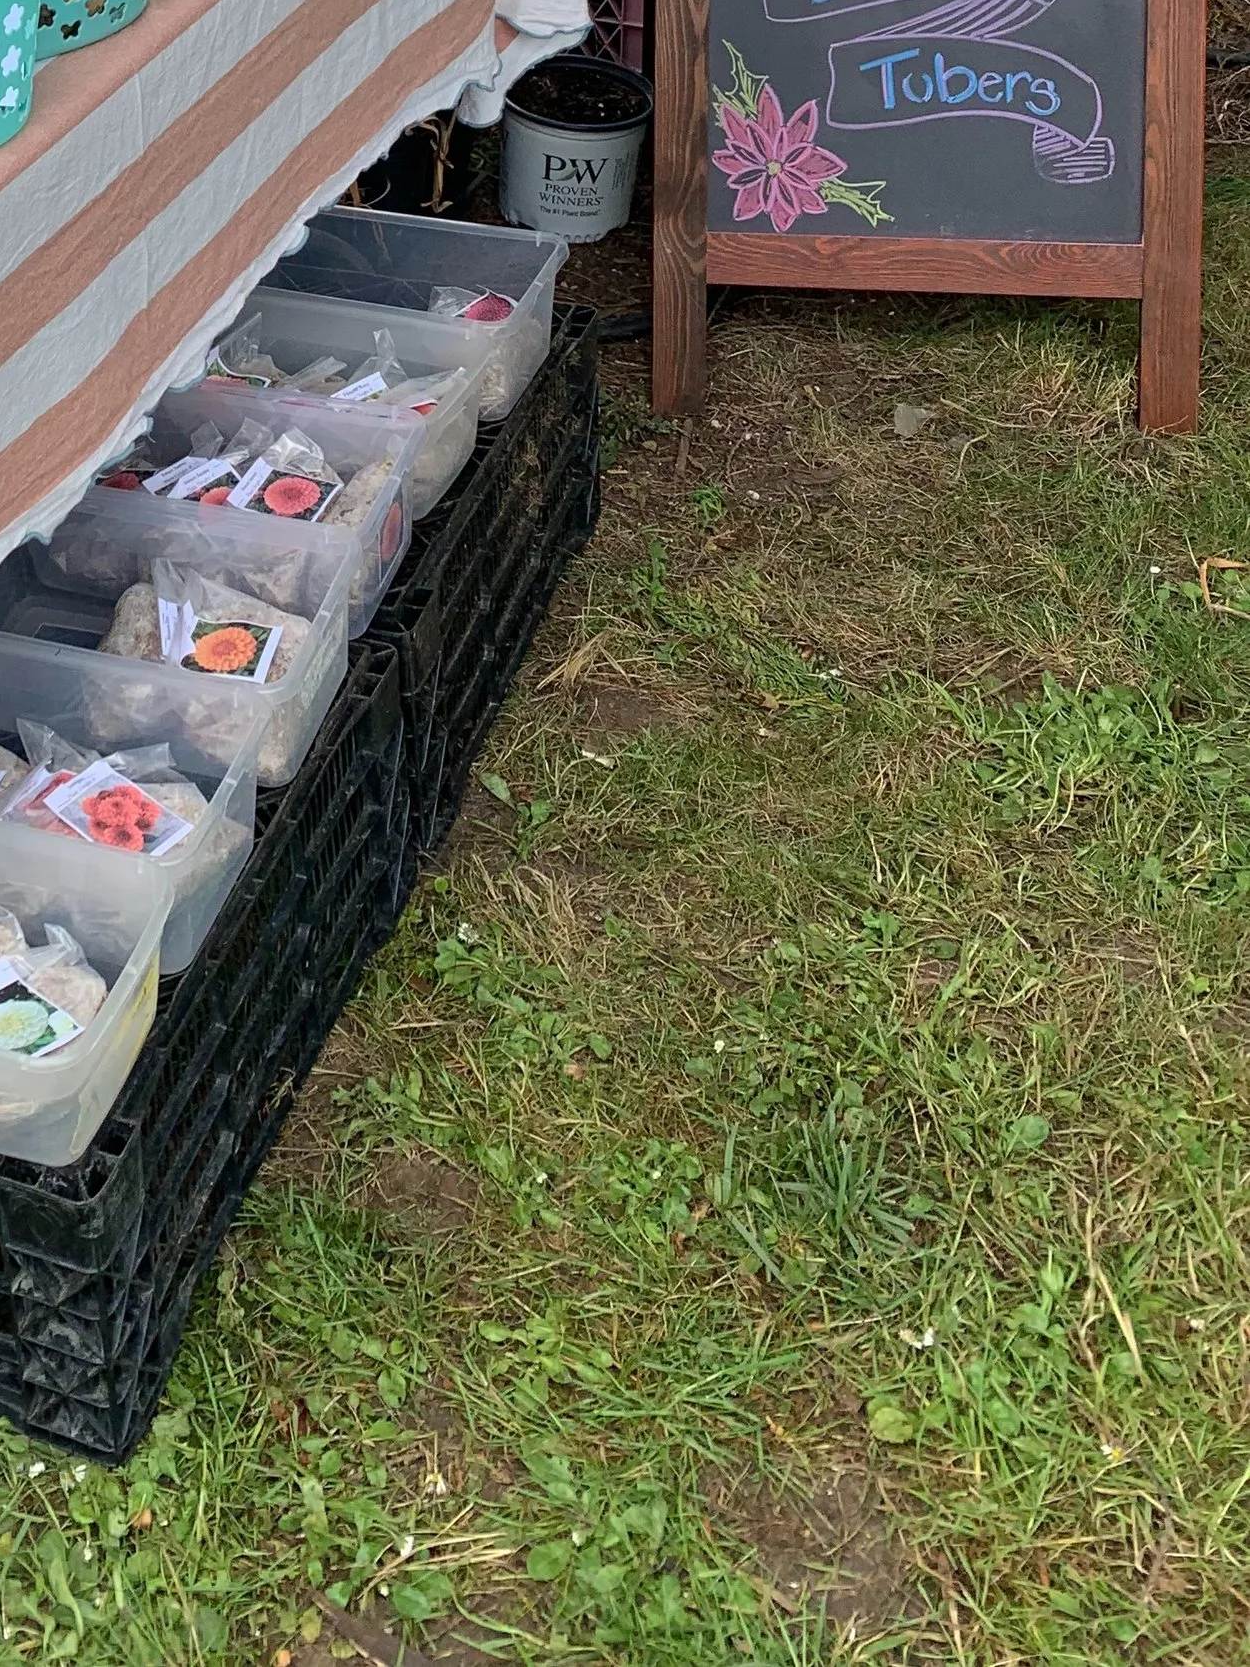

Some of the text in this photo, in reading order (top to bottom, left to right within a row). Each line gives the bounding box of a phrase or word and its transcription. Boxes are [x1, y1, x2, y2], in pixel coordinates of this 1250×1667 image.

[859, 48, 1060, 114] Tubers
[544, 183, 599, 197] PROVEN
[539, 192, 602, 207] WINNERS
